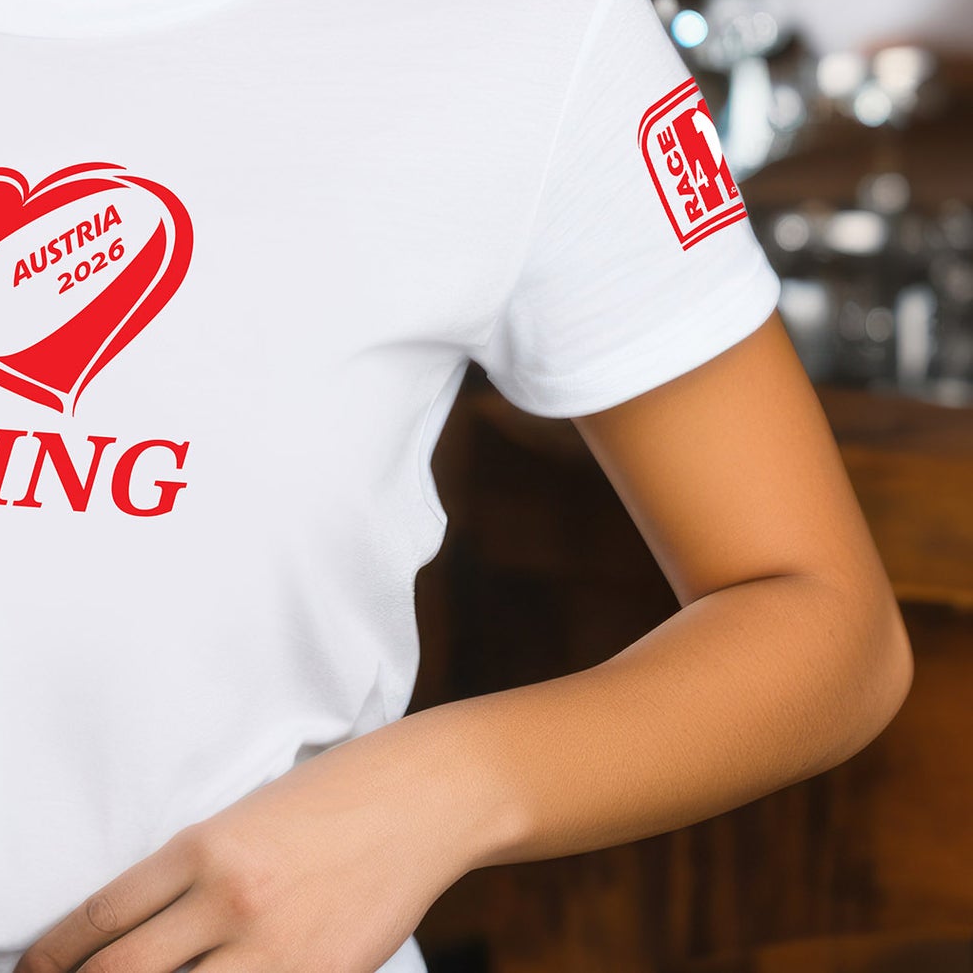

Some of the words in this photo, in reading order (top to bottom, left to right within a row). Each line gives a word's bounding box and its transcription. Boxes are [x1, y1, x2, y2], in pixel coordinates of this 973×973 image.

[657, 126, 704, 223] RACE
[14, 205, 122, 286] AUSTRIA
[58, 238, 125, 294] 2026
